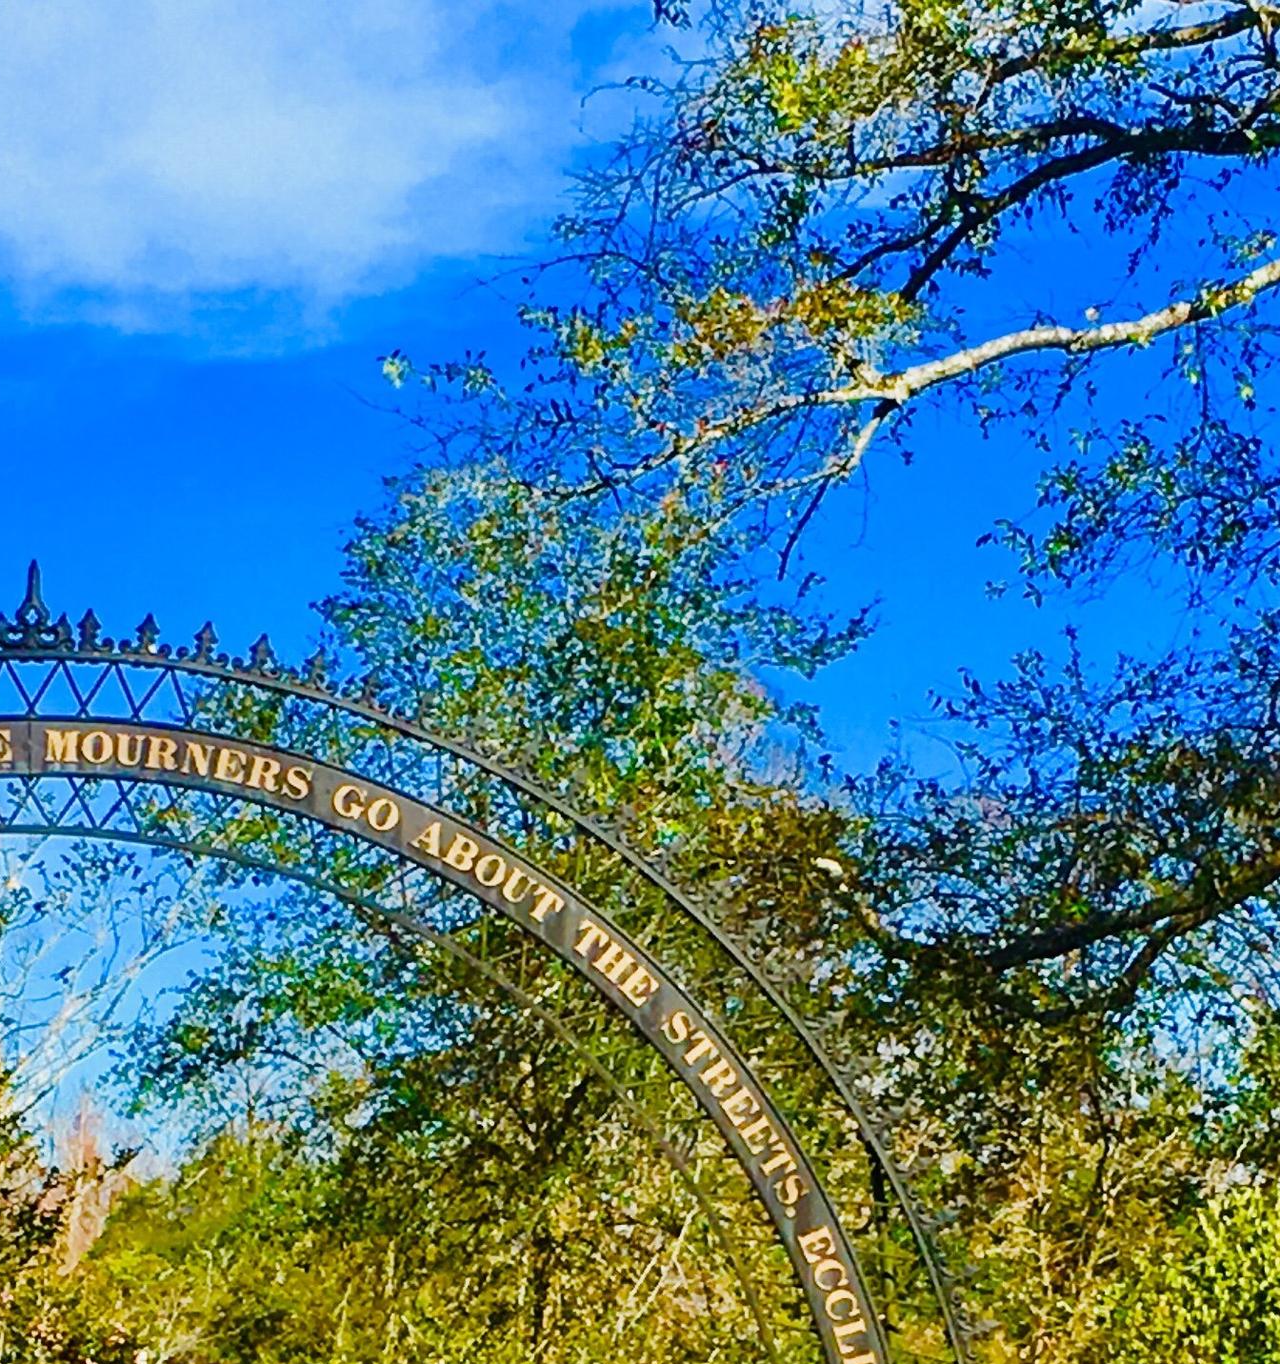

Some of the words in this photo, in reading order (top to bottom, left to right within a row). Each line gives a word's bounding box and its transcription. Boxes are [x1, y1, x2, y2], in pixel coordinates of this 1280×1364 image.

[44, 729, 314, 801] MOURNERS
[332, 784, 401, 833] GO
[412, 819, 566, 925] ABOUT
[573, 919, 660, 1007] THE
[661, 1010, 809, 1218] STREETS.
